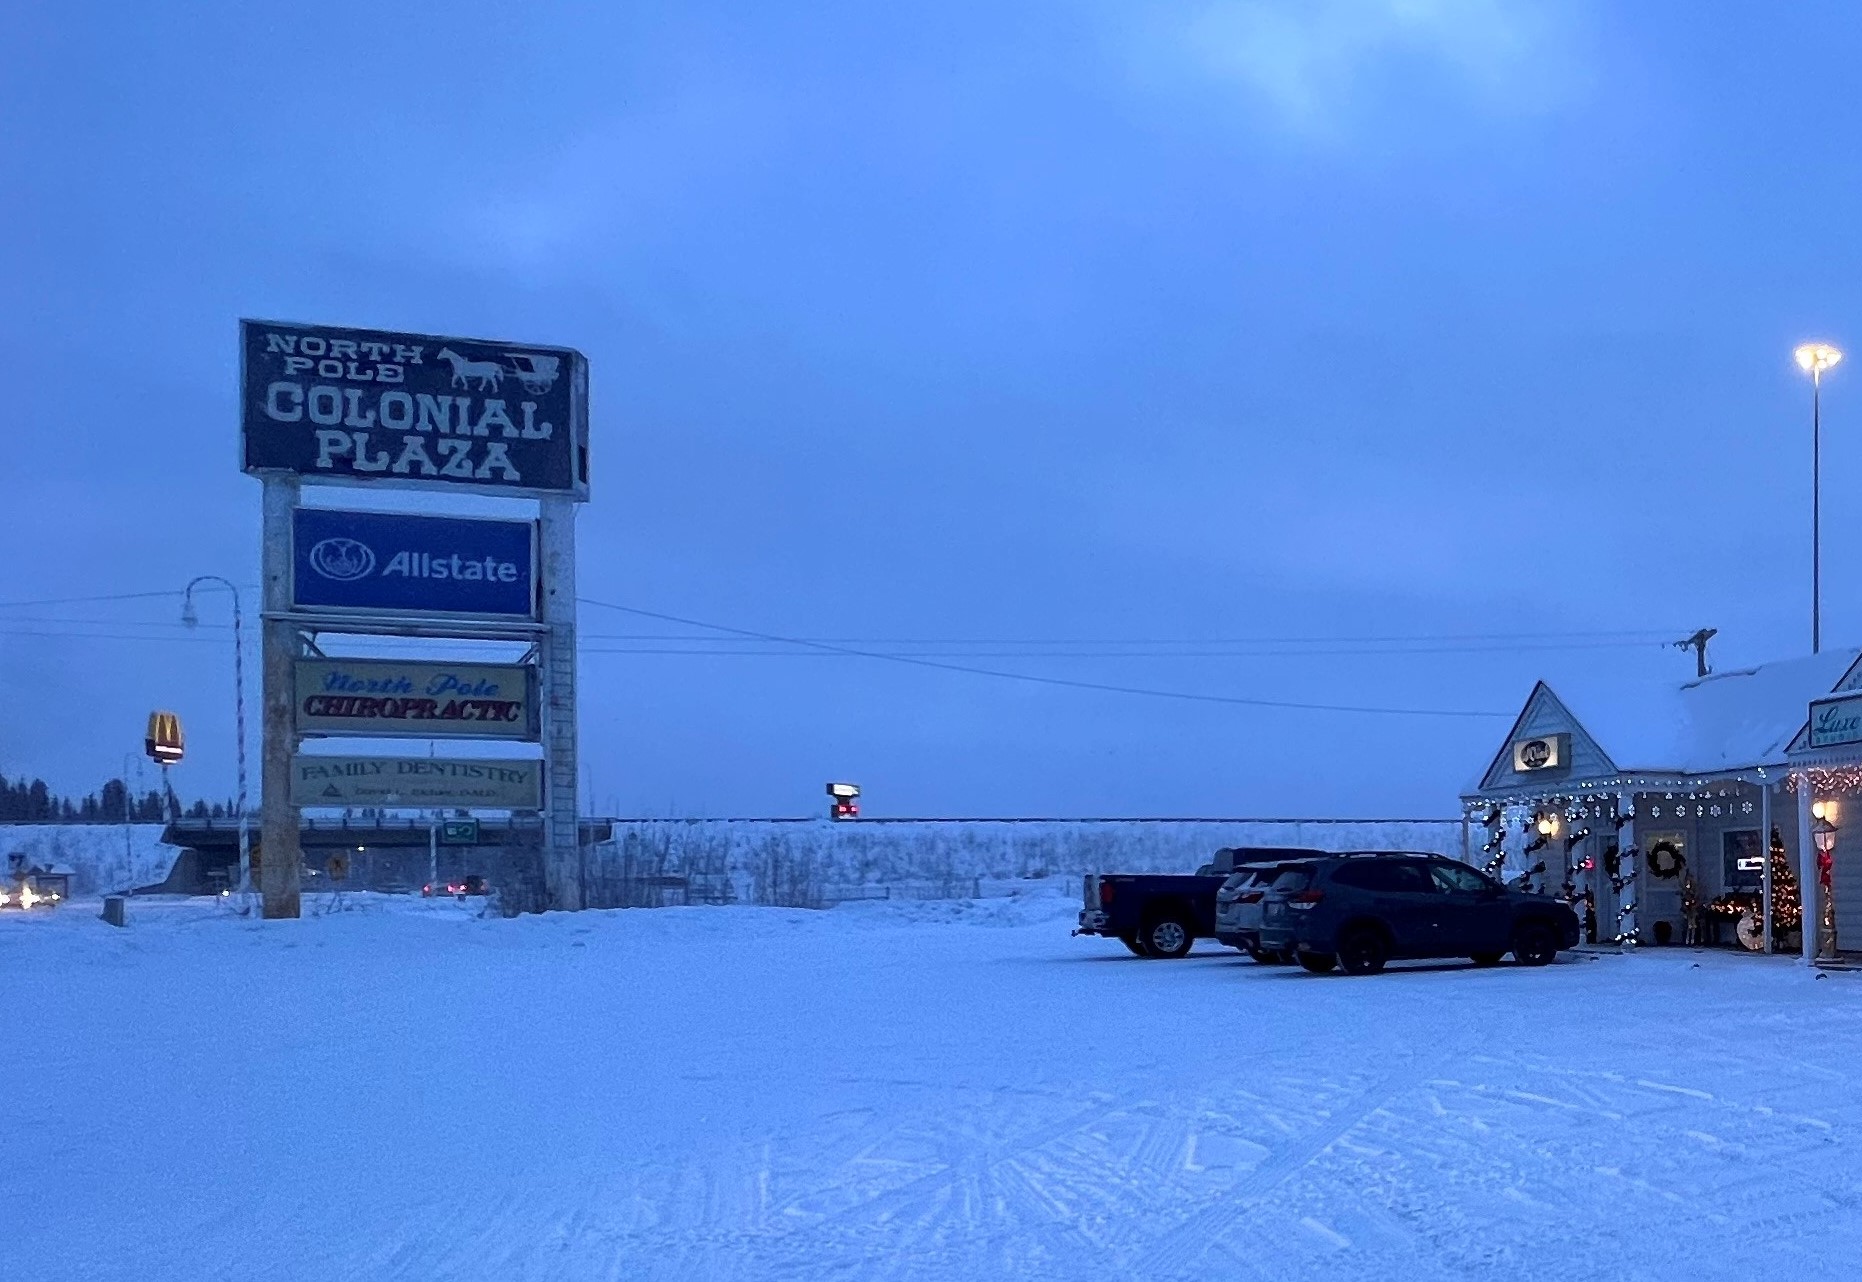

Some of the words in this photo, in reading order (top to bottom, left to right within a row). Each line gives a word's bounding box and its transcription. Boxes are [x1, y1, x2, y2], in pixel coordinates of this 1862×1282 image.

[266, 333, 425, 365] NORTH
[284, 356, 405, 383] POLE
[266, 381, 553, 440] COLONIAL
[315, 429, 521, 482] PLAZA
[382, 551, 519, 582] Allstate
[323, 670, 414, 693] North
[426, 673, 499, 697] Pole
[304, 694, 522, 722] CHIROPRACTIC
[301, 761, 387, 781] FAMILY
[397, 760, 528, 784] DENTISTRY
